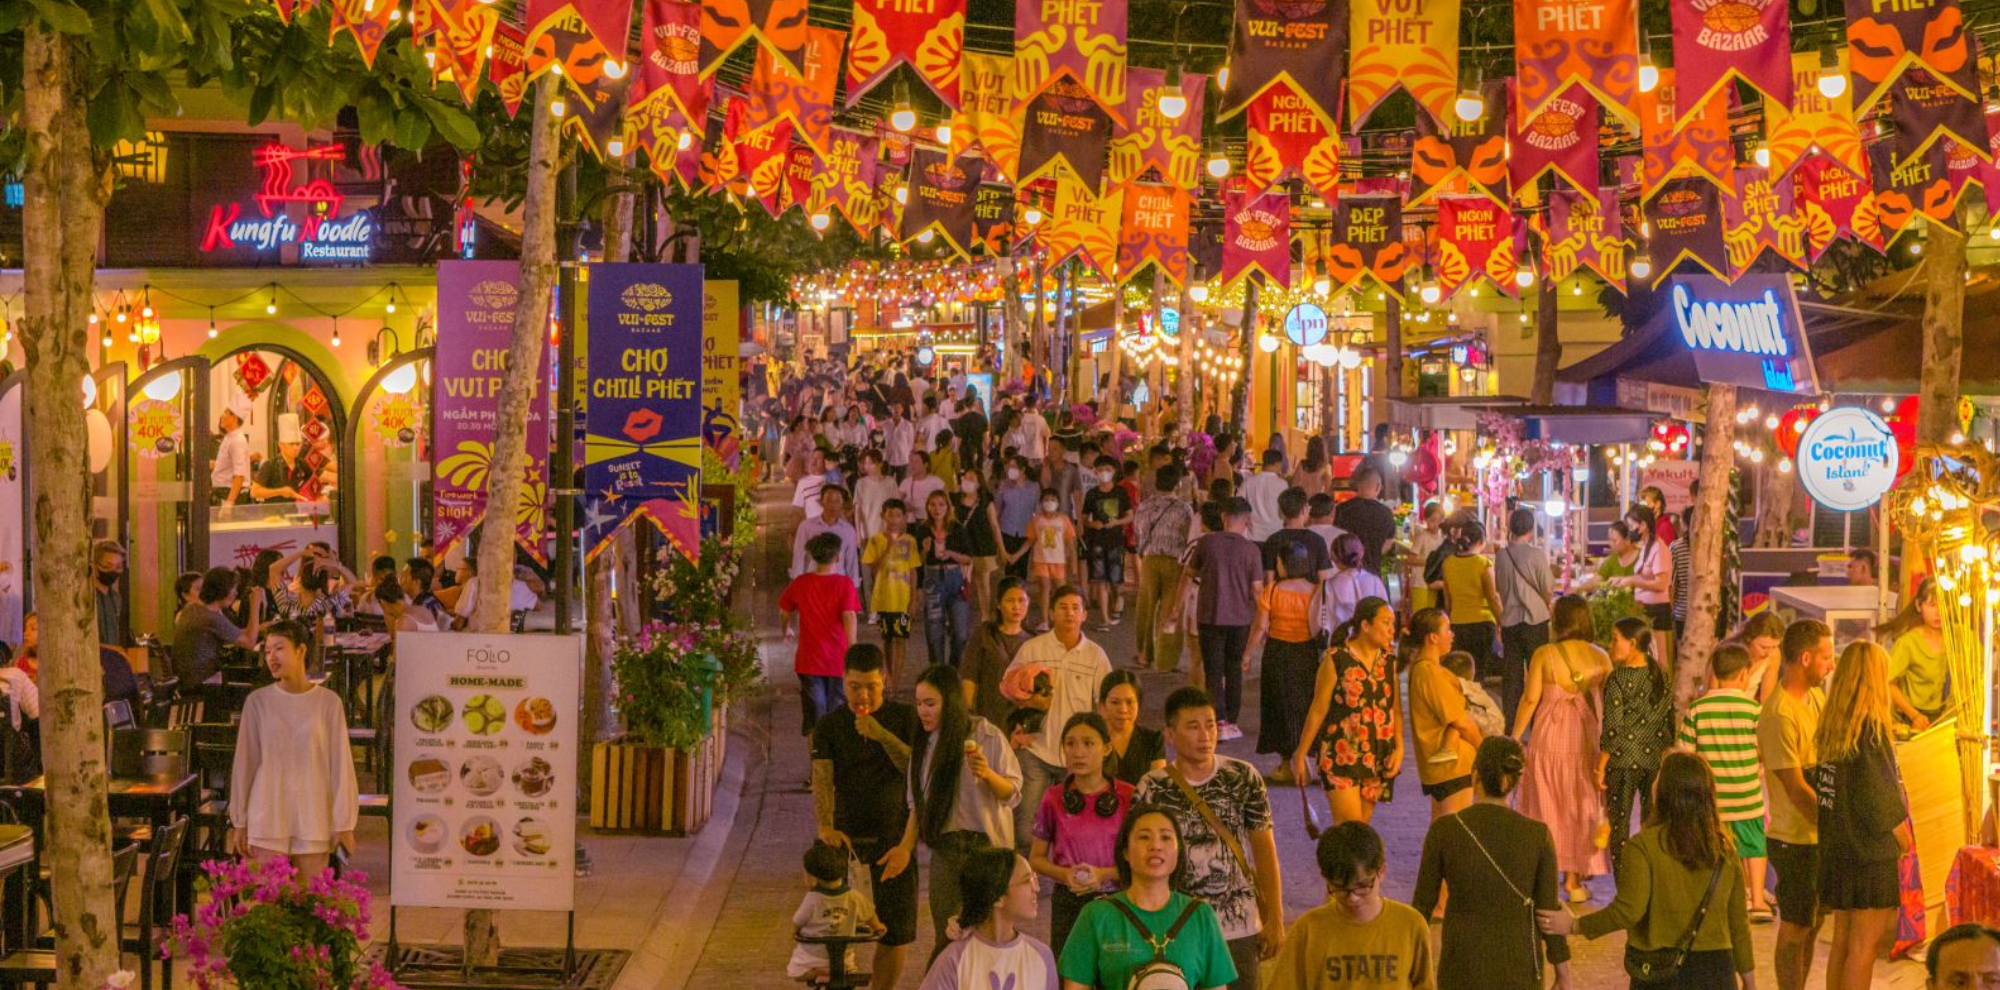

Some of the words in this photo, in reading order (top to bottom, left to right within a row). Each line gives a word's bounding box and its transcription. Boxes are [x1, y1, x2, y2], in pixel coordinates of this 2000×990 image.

[654, 22, 700, 46] VUI-FES
[1248, 20, 1328, 39] VUI-FEST
[1369, 17, 1433, 45] PHẾT
[1696, 24, 1769, 51] BAZAAR
[972, 71, 1005, 90] VUI
[834, 140, 859, 158] SAY
[1526, 130, 1580, 150] BAZAAR
[1745, 180, 1773, 199] SAY
[1138, 195, 1173, 210] CHILL
[1234, 208, 1282, 229] VUI-FEST
[1457, 209, 1493, 222] NGON
[203, 204, 295, 252] Kungfu
[299, 214, 370, 242] Noodle
[303, 242, 369, 258] Restaurant
[1234, 233, 1279, 251] BAZAAR
[465, 310, 515, 324] VUI-FES
[618, 313, 675, 326] VUI-FEST
[1672, 283, 1788, 356] Coconut
[621, 348, 668, 377] CHỢ
[1761, 359, 1796, 392] Island
[444, 377, 484, 397] VUI
[593, 377, 642, 399] CHILL
[646, 376, 696, 400] PHẾT
[137, 425, 164, 438] 40K
[383, 417, 406, 429] 40K
[1811, 440, 1885, 461] Coconut
[1648, 469, 1693, 480] Yakult
[450, 677, 524, 688] HOME-MADE
[1325, 953, 1399, 983] STATE
